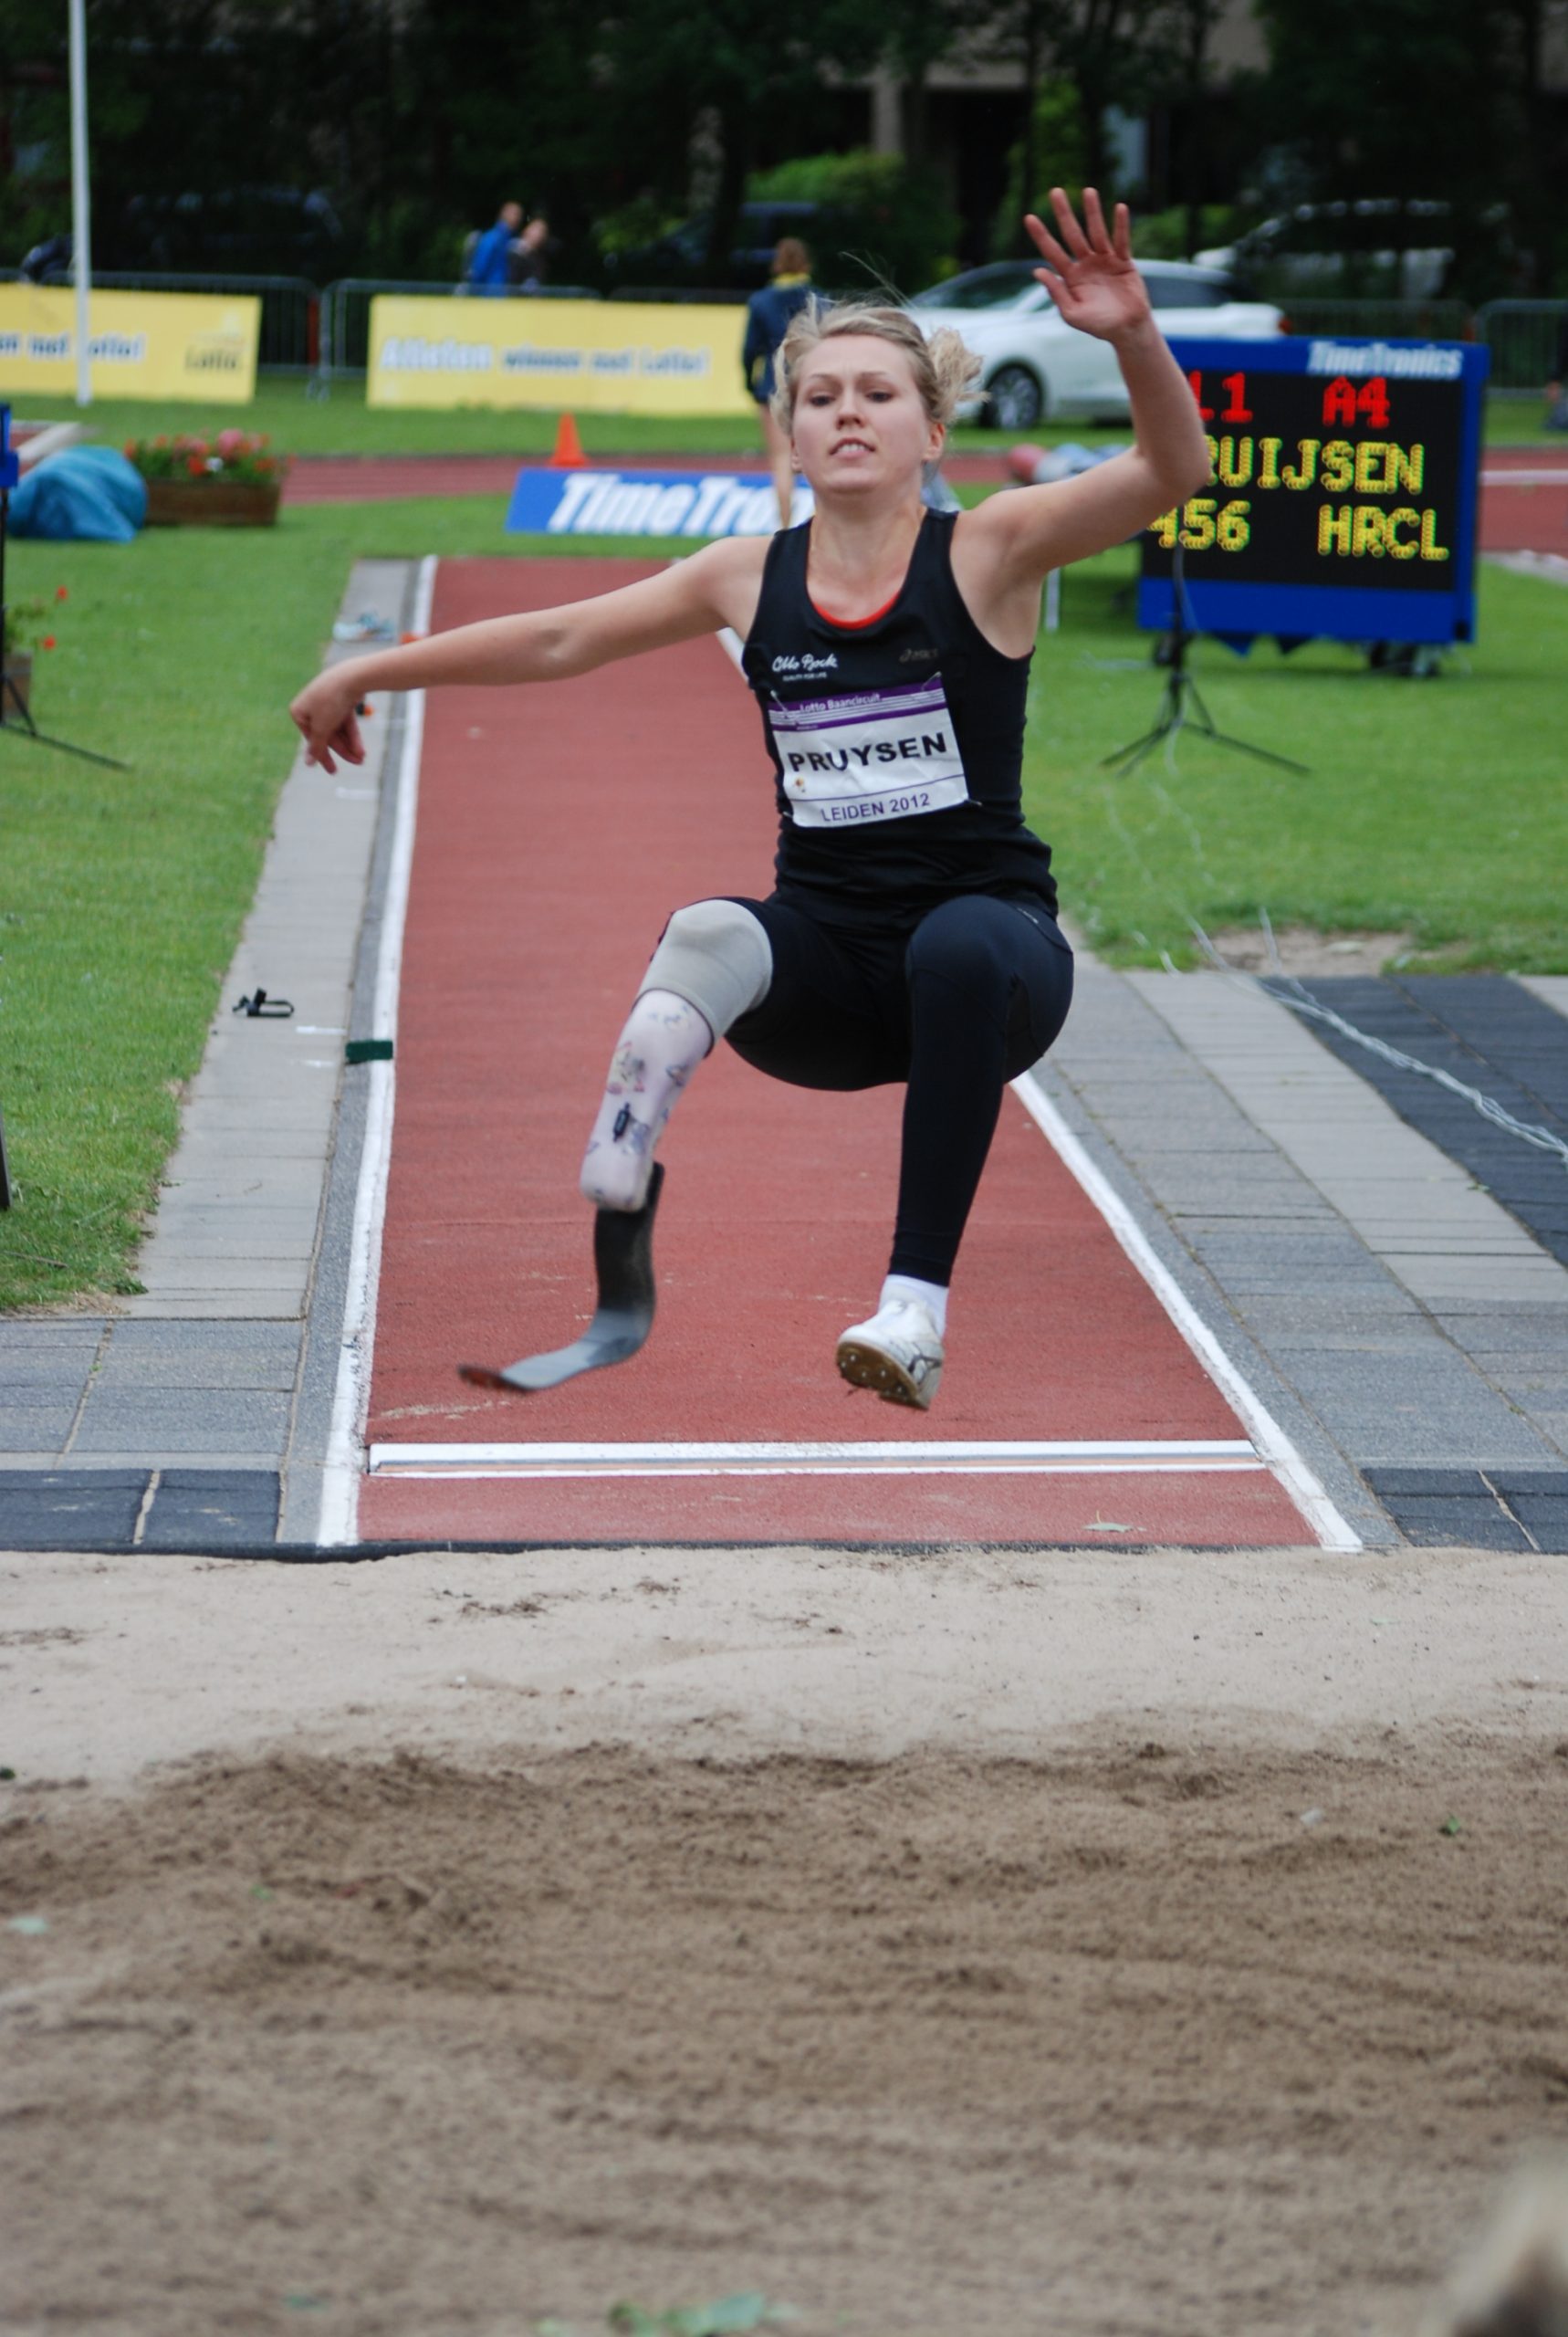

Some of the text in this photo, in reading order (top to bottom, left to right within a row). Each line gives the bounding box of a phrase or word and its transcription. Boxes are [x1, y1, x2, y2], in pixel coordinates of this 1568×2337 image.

[1307, 341, 1463, 379] TimeTronics
[1322, 375, 1391, 429] A4
[1317, 504, 1450, 561] HRCL
[800, 692, 882, 713] Lotto Baancircuit
[787, 731, 948, 773] PRUYSEN
[821, 791, 931, 823] LEIDEN 2012
